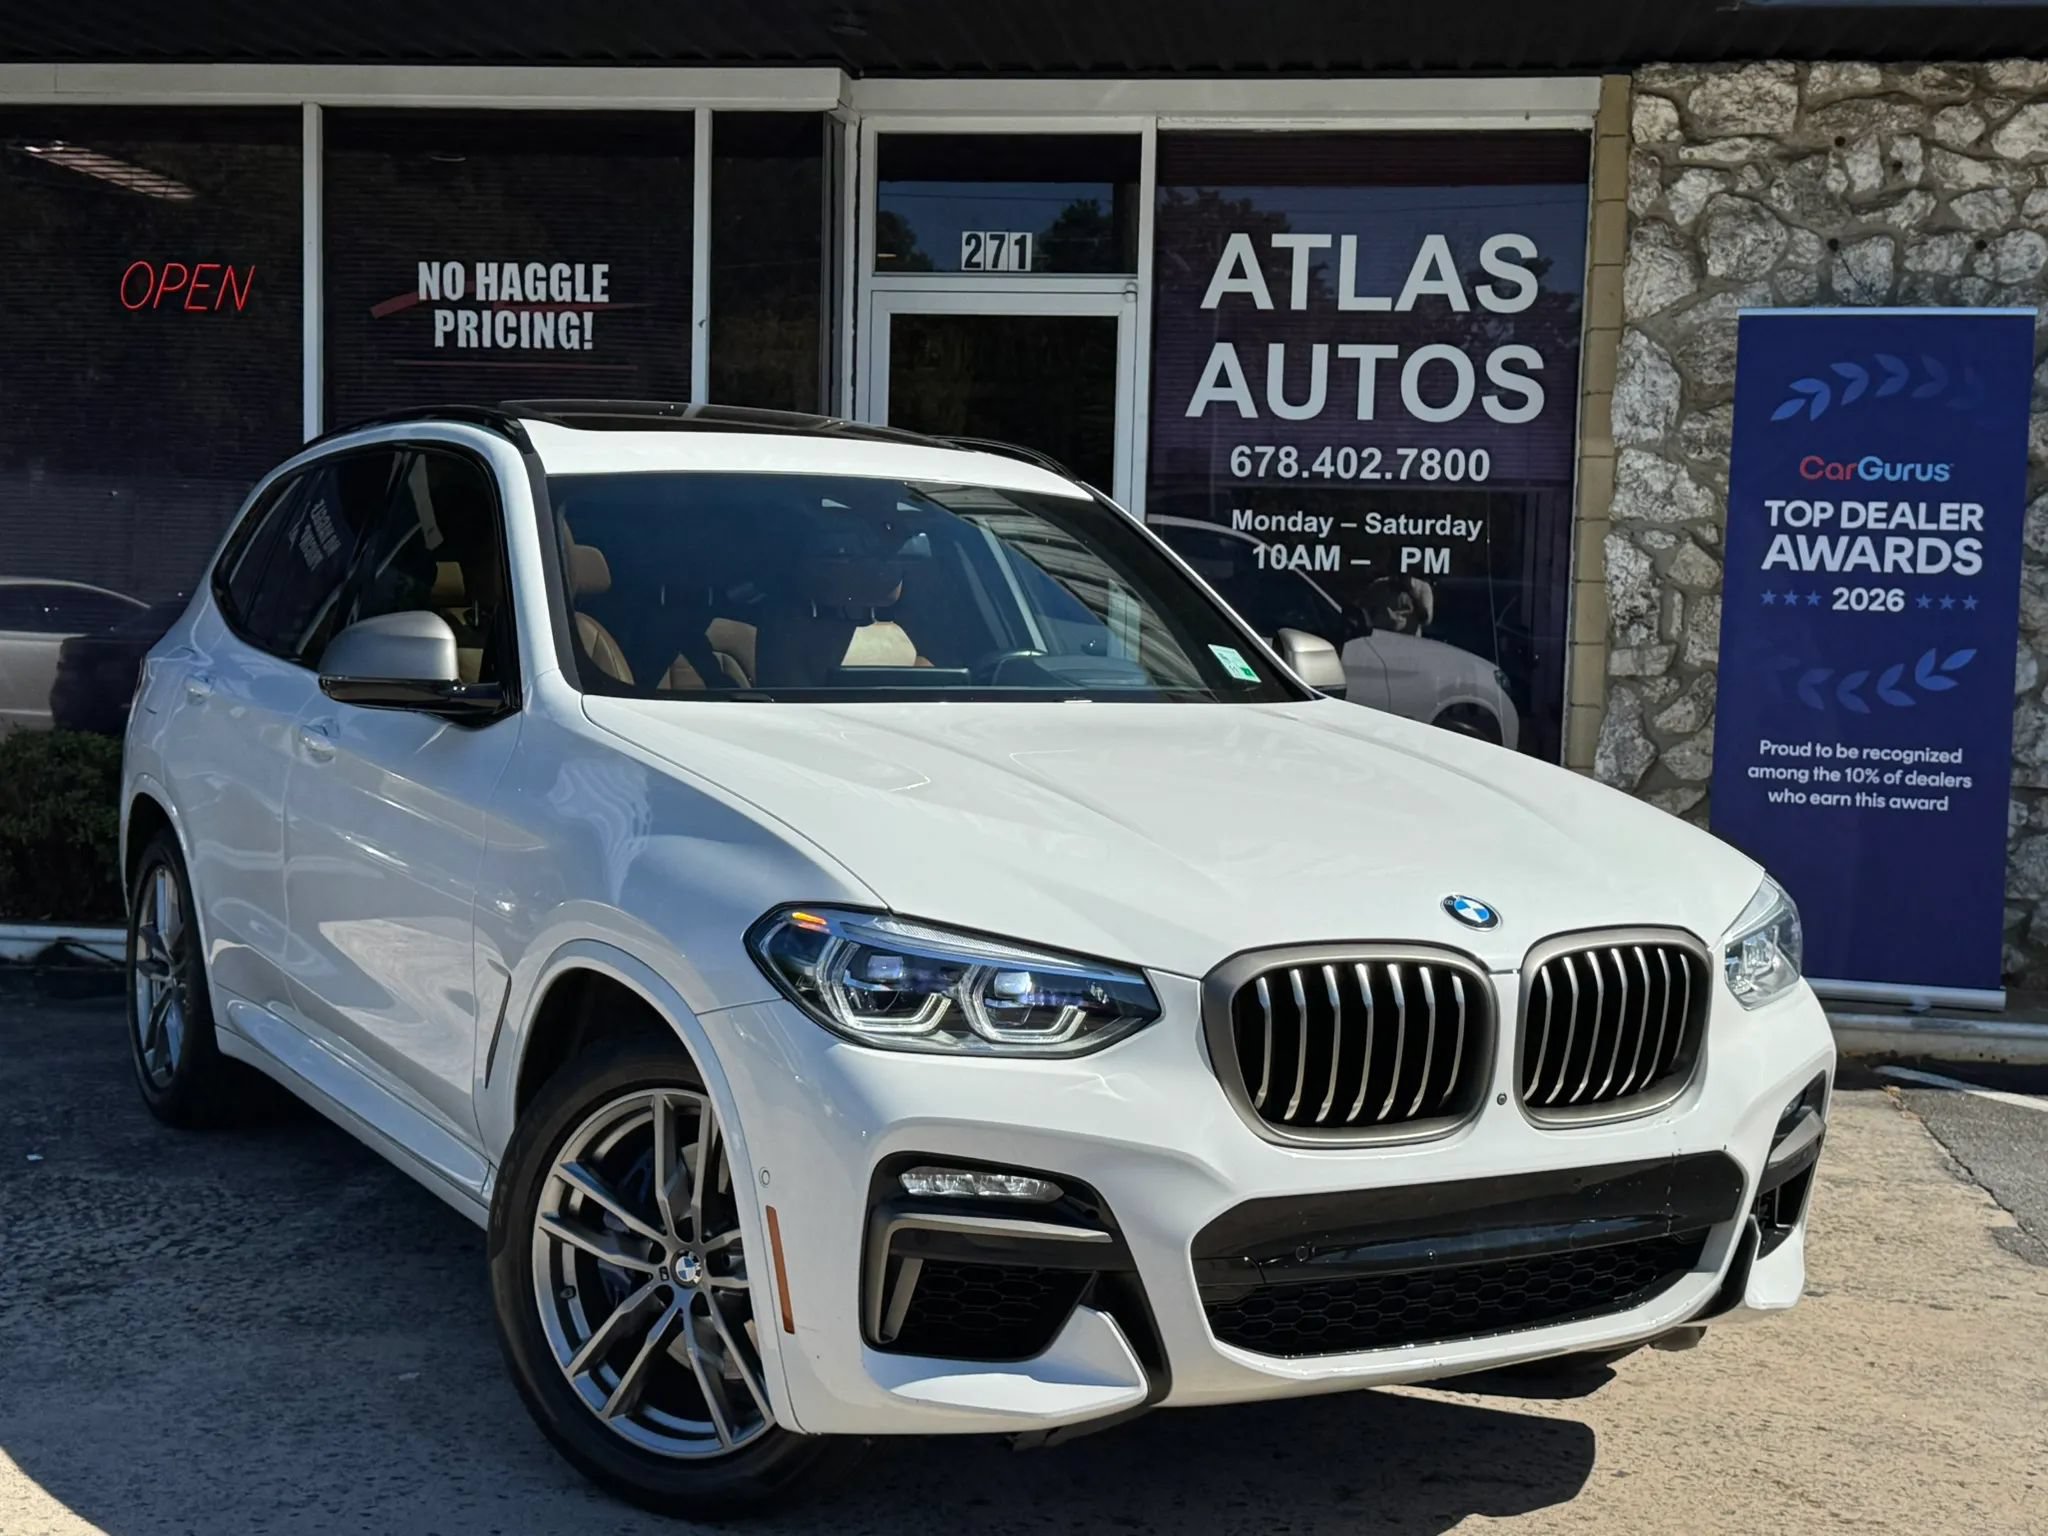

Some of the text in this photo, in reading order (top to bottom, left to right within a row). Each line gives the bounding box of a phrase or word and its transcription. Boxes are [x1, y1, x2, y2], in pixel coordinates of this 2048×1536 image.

[964, 233, 1027, 269] 271
[120, 260, 255, 311] OPEN
[418, 261, 609, 303] NO HAGGLE
[1200, 233, 1539, 314] ATLAS
[434, 309, 594, 350] PRICING!
[1184, 342, 1545, 424] AUTOS
[1230, 445, 1490, 482] 678.402.7800
[1799, 455, 1951, 482] CarGurus
[1231, 508, 1334, 538] Monday
[1364, 512, 1483, 541] Saturday
[1764, 500, 1984, 532] TOP DEALER
[1252, 544, 1341, 572] 10AM
[1400, 546, 1451, 574] PM
[1760, 534, 1983, 576] AWARDS
[1832, 586, 1905, 612] 2026
[1759, 739, 1963, 765] Proud to be recognized
[1747, 765, 1973, 789] among the 10% of dealers
[1767, 788, 1949, 811] who earn this award
